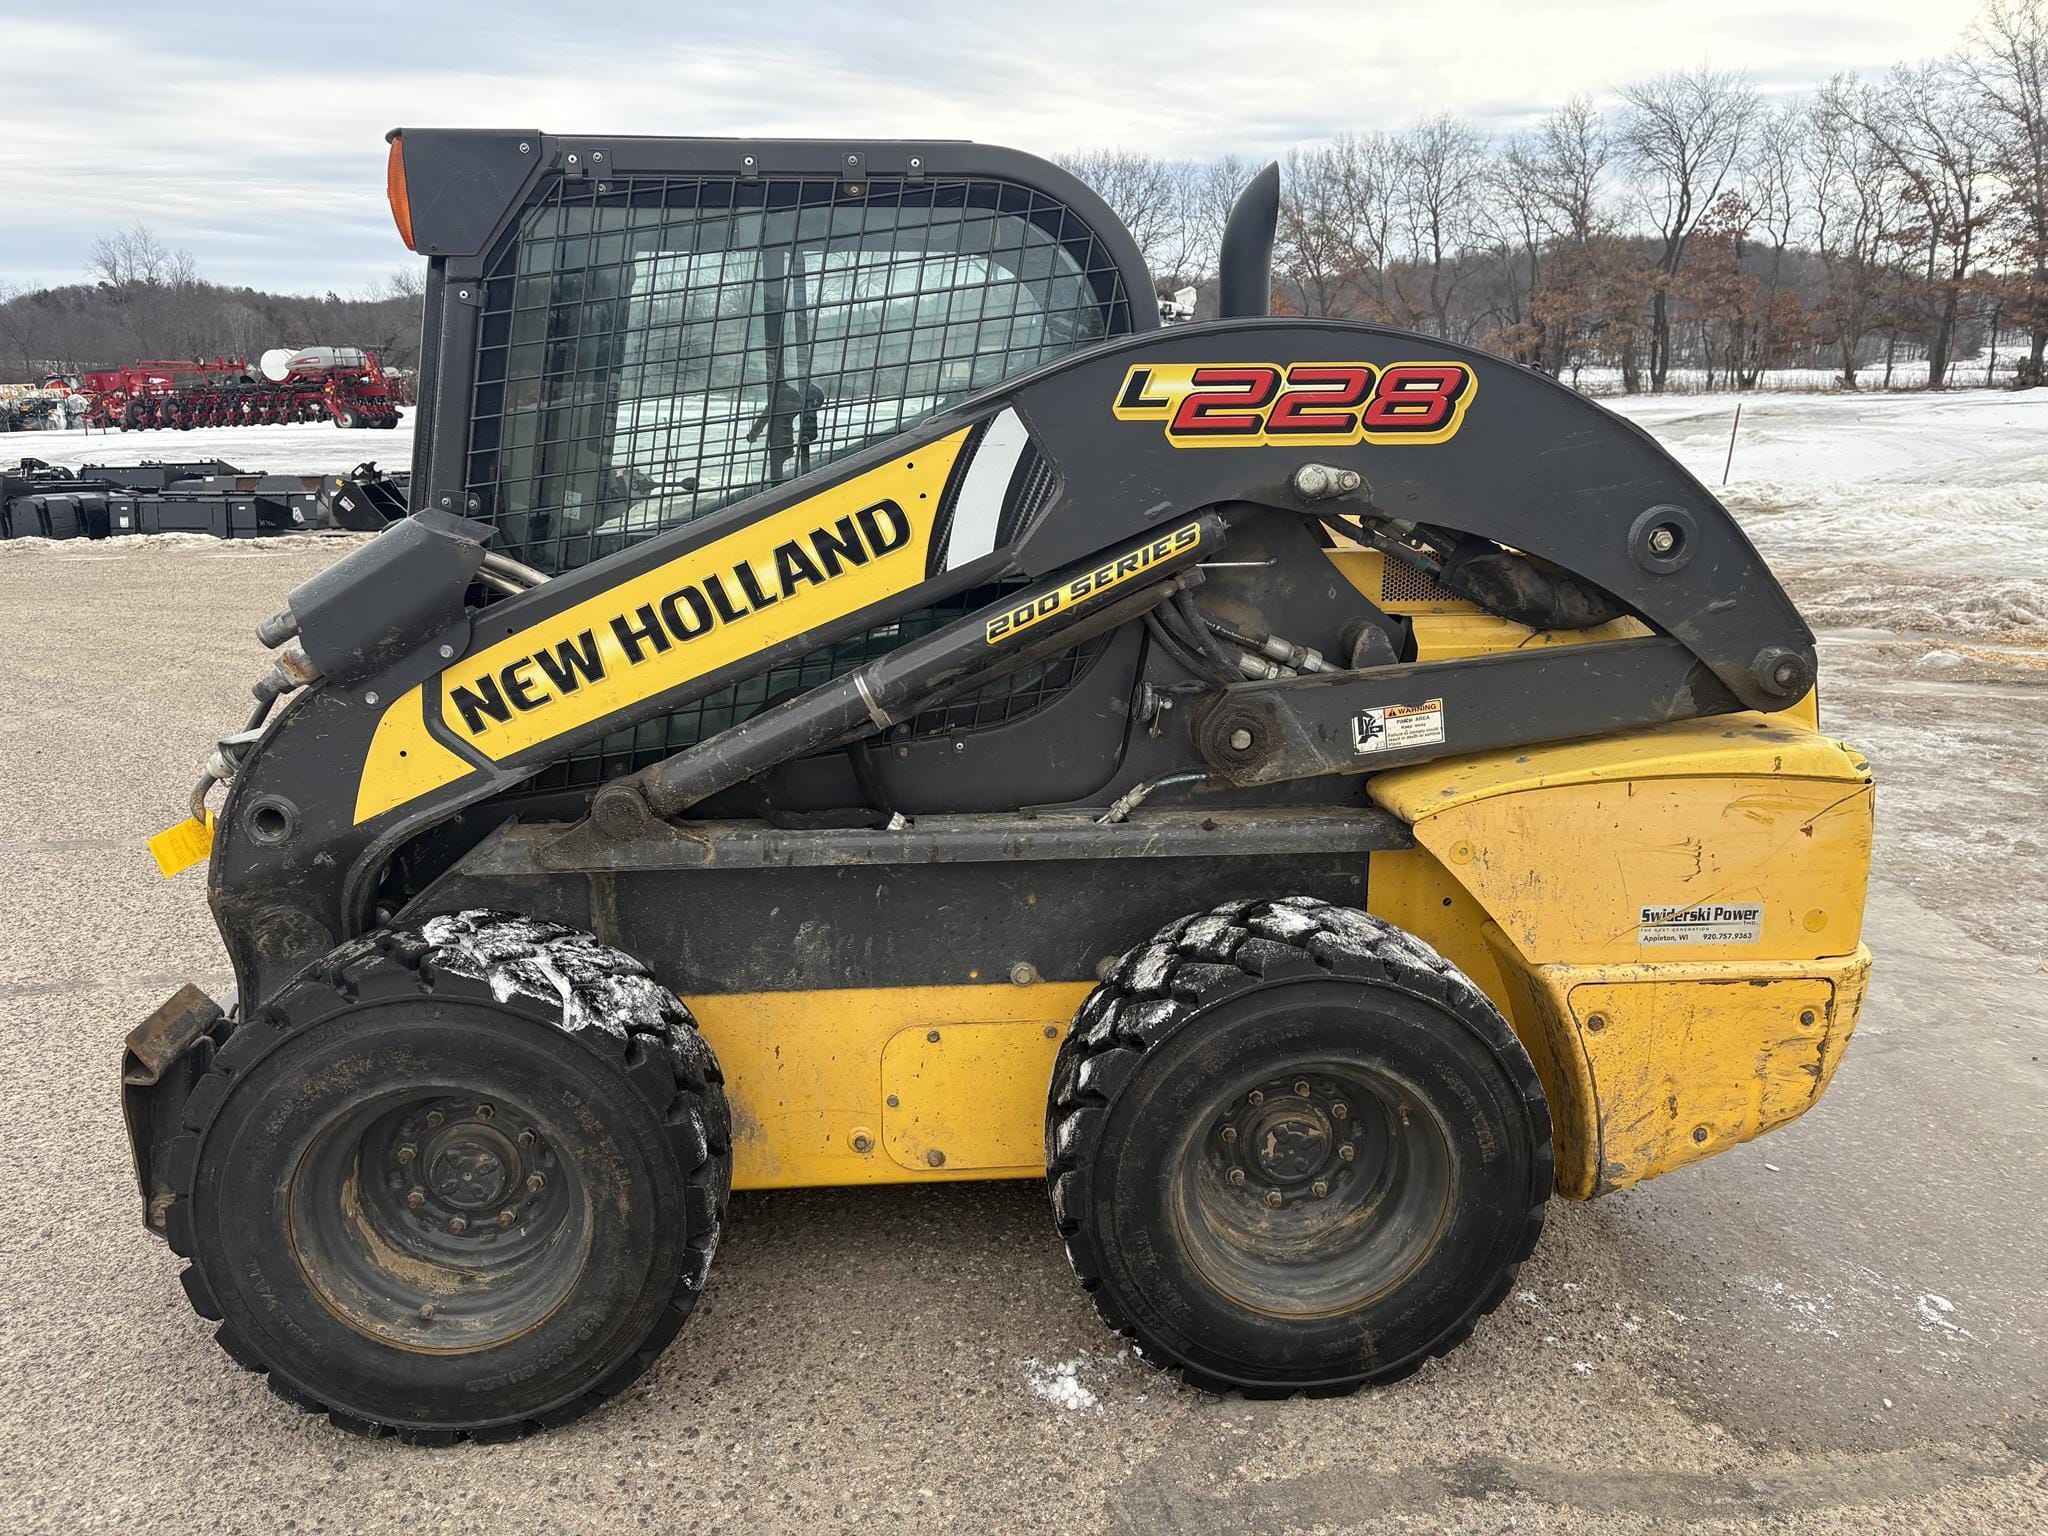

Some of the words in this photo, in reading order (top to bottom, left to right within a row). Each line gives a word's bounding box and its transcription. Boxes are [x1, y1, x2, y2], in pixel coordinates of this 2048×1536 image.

[1115, 365, 1474, 440] L228
[988, 591, 1061, 641] 200
[1069, 524, 1197, 601] SERIES
[450, 627, 607, 735] NEW
[609, 498, 912, 666] HOLLAND
[1397, 703, 1437, 714] WARNING
[1641, 907, 1711, 923] Swiderski
[1713, 907, 1759, 921] Power
[1642, 934, 1677, 943] Appleton,
[1702, 932, 1752, 941] 920.757.9363
